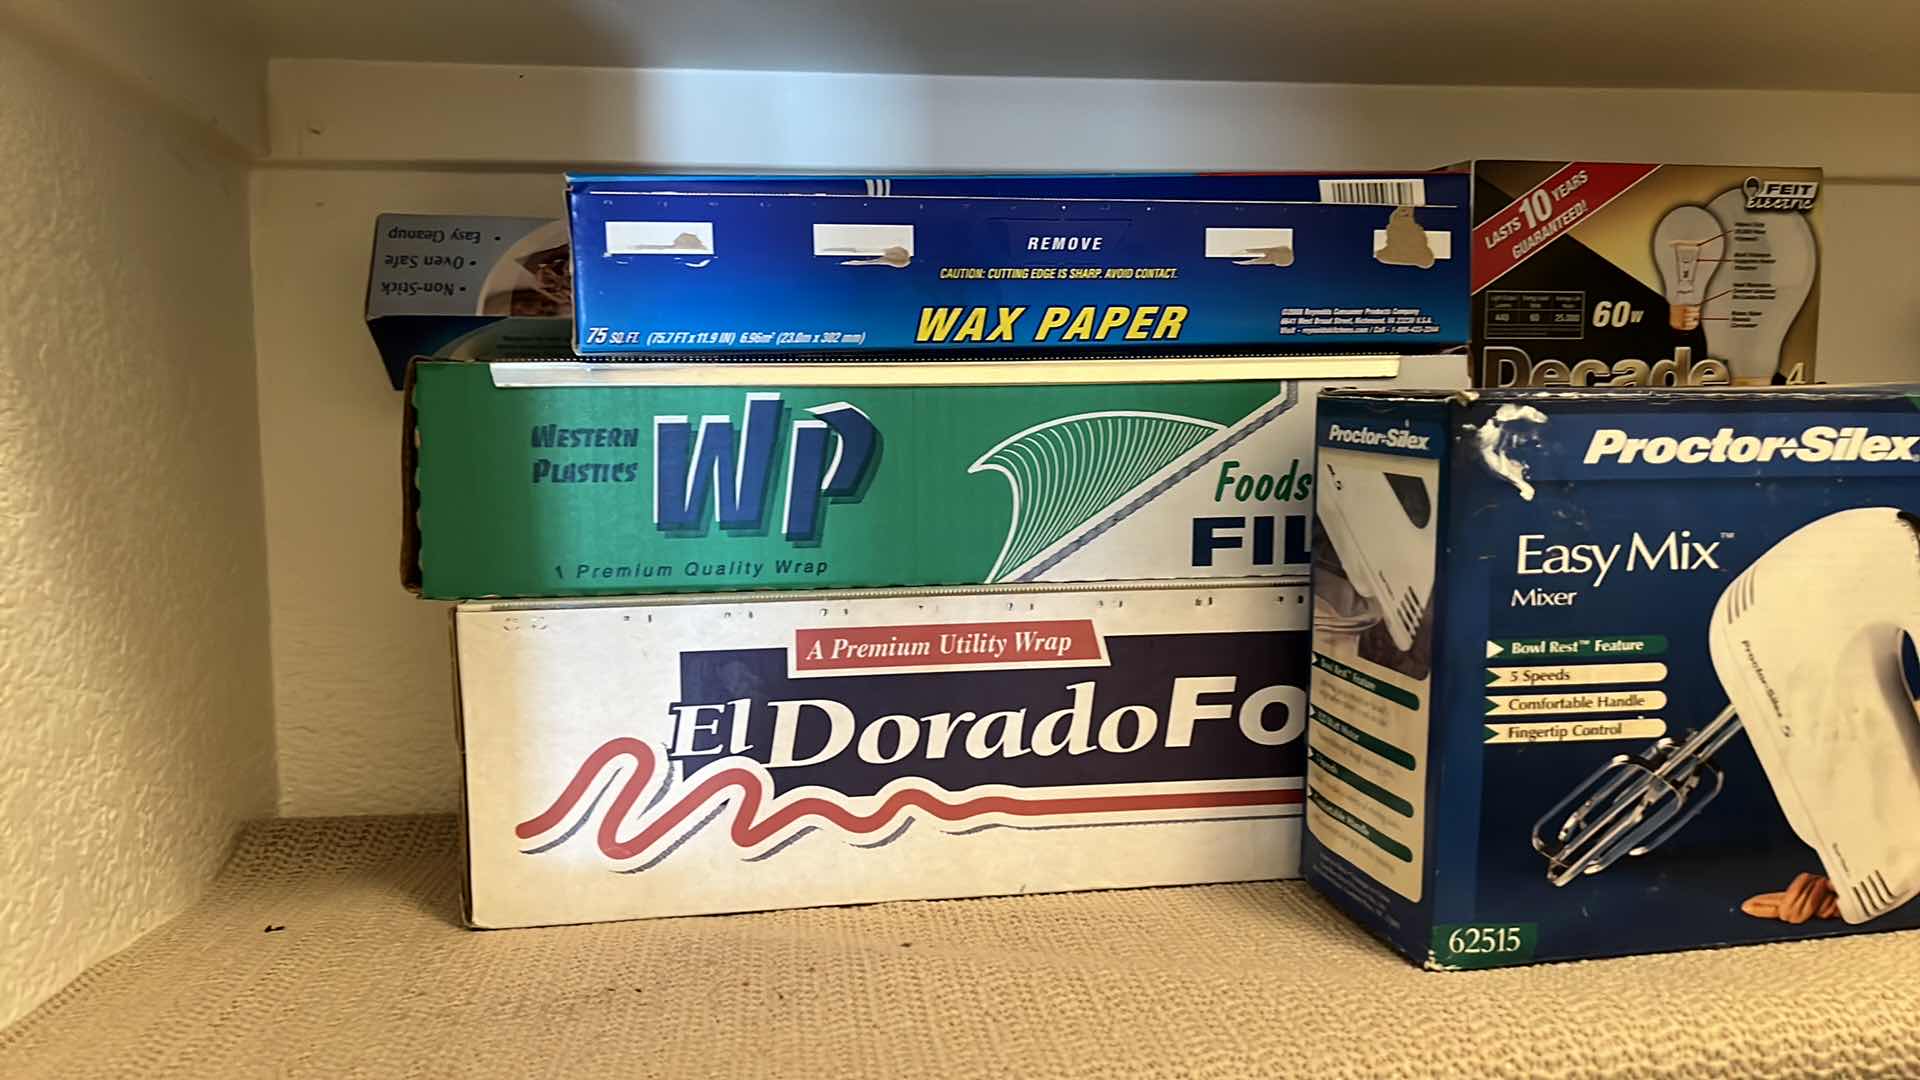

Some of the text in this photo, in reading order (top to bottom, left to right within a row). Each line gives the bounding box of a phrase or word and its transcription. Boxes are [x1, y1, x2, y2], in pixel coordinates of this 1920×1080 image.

[1765, 183, 1813, 196] FEIT
[1484, 169, 1589, 249] LASTS 10 YEARS
[387, 226, 481, 244] Easy Cleanup
[1511, 199, 1589, 260] GUARANTEED!
[1027, 236, 1103, 251] REMOVE
[384, 254, 465, 269] Oven Safe
[939, 267, 986, 280] CAUTION:
[988, 267, 1029, 280] CUTTING
[1031, 267, 1056, 280] EDGE
[1057, 267, 1068, 280] IS
[1104, 267, 1134, 280] AVOID
[380, 281, 455, 297] Non-Stick
[914, 305, 1190, 343] WAX PAPER
[587, 327, 609, 344] 75
[1482, 346, 1732, 390] Decade
[1786, 362, 1807, 385] 4
[531, 423, 639, 449] WESTERN
[531, 458, 639, 484] PLASTICS
[1214, 458, 1312, 503] Foods
[575, 563, 673, 580] Premium
[683, 561, 764, 579] Quality
[774, 559, 829, 577] Wrap
[1516, 533, 1622, 588] Easy
[1510, 588, 1579, 608] Mixer
[805, 631, 1073, 661] A Premium Utility Wrap
[1510, 639, 1546, 655] Bowl
[1593, 639, 1645, 653] Feature
[1509, 668, 1571, 686] 5 Speeds
[1507, 694, 1646, 712] Comfortable Handle
[669, 698, 755, 758] El
[1507, 722, 1623, 741] Fingertip Control
[1448, 927, 1521, 954] 62515
